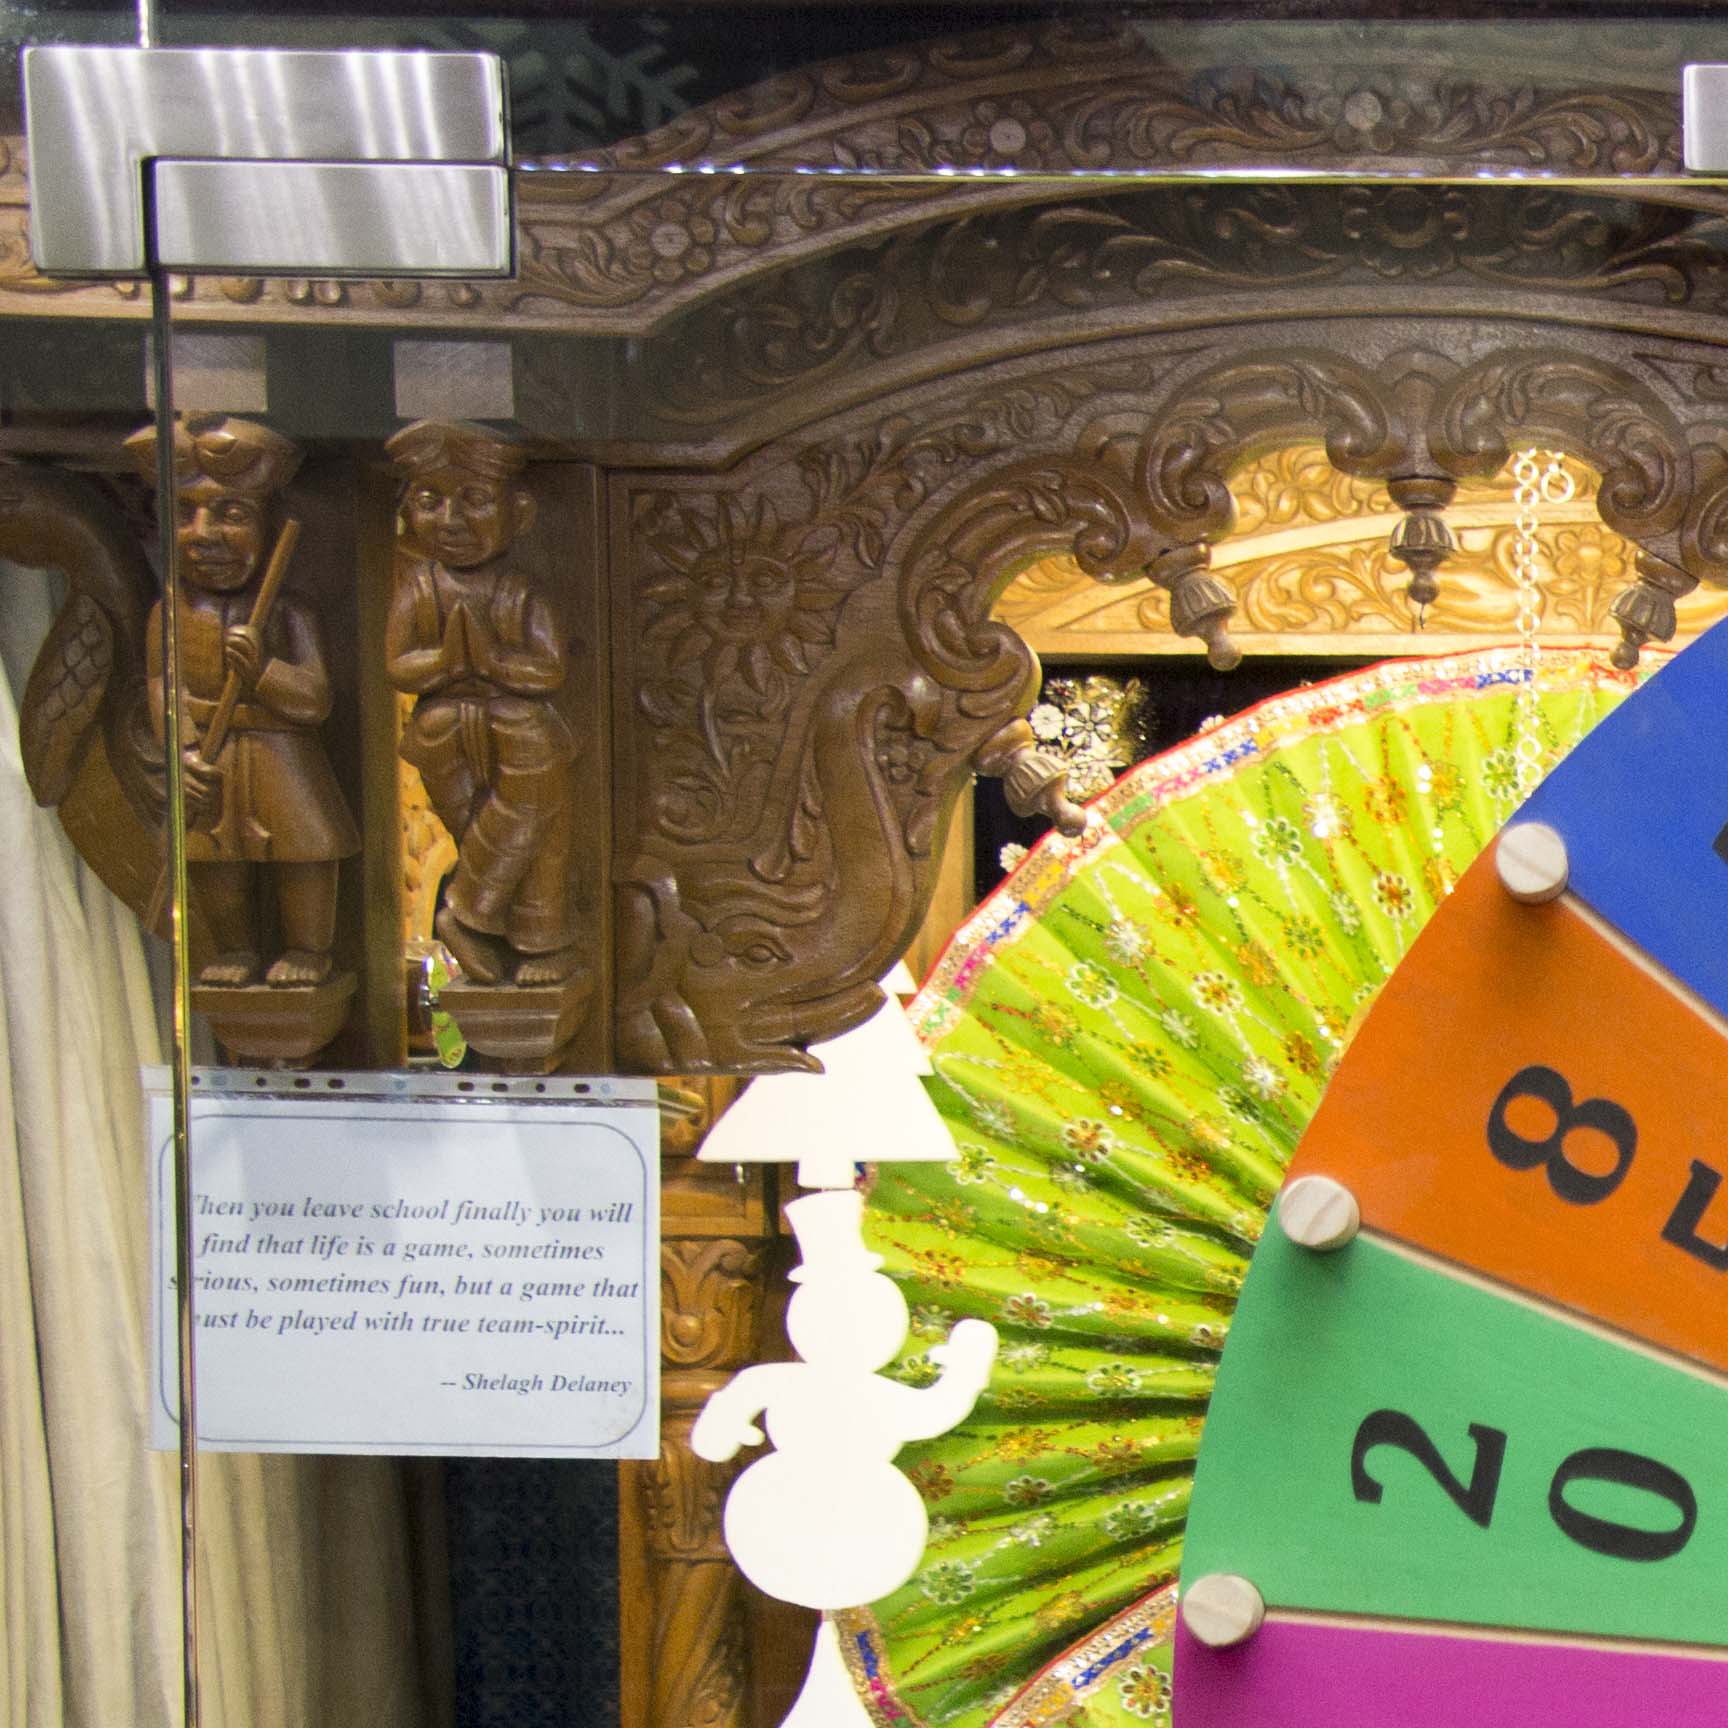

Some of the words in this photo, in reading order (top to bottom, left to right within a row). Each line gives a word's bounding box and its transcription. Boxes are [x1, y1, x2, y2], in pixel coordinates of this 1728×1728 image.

[250, 1201, 296, 1221] you
[303, 1198, 365, 1218] leave
[372, 1199, 448, 1220] school
[450, 1200, 531, 1226] finally
[536, 1206, 580, 1226] you
[590, 1202, 633, 1223] will
[197, 1233, 250, 1258] find
[256, 1234, 302, 1255] that
[311, 1235, 349, 1260] life
[356, 1236, 374, 1256] is
[382, 1243, 395, 1256] a
[402, 1242, 473, 1261] game,
[481, 1240, 605, 1260] sometimes
[168, 1270, 258, 1292] sious,
[266, 1273, 390, 1293] sometimes
[394, 1275, 445, 1299] fun,
[454, 1275, 493, 1296] but
[500, 1282, 512, 1296] a
[520, 1283, 586, 1301] game
[592, 1278, 639, 1298] that
[193, 1311, 238, 1328] ust
[245, 1309, 272, 1330] be
[278, 1310, 358, 1335] played
[365, 1311, 414, 1332] with
[422, 1315, 470, 1333] true
[477, 1315, 624, 1340] team-spirit...
[462, 1372, 543, 1395] Shelagh
[550, 1374, 632, 1397] Delaney
